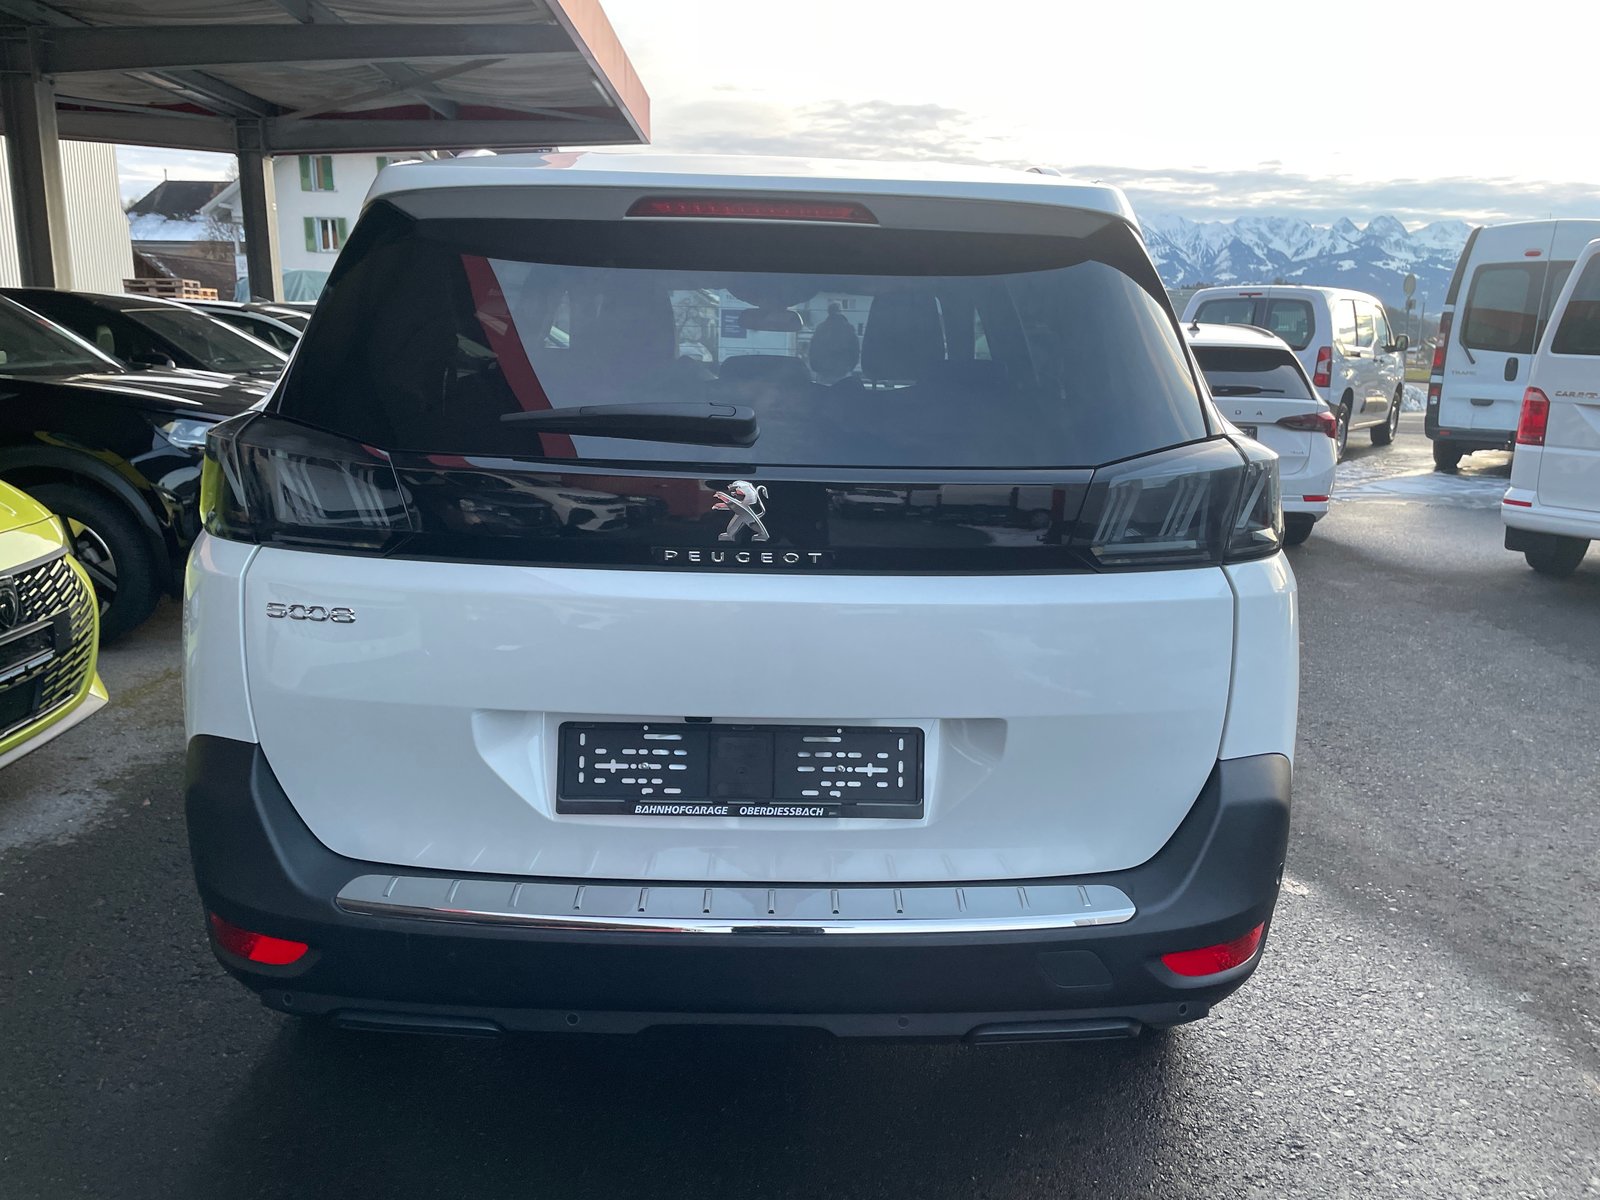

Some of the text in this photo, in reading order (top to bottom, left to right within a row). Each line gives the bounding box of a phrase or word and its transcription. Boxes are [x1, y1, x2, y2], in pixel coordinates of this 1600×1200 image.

[664, 550, 822, 564] PEUGEOT
[266, 602, 356, 623] 5008
[634, 805, 824, 816] BAHNHOFGARAGE OBERDIESSBACH
